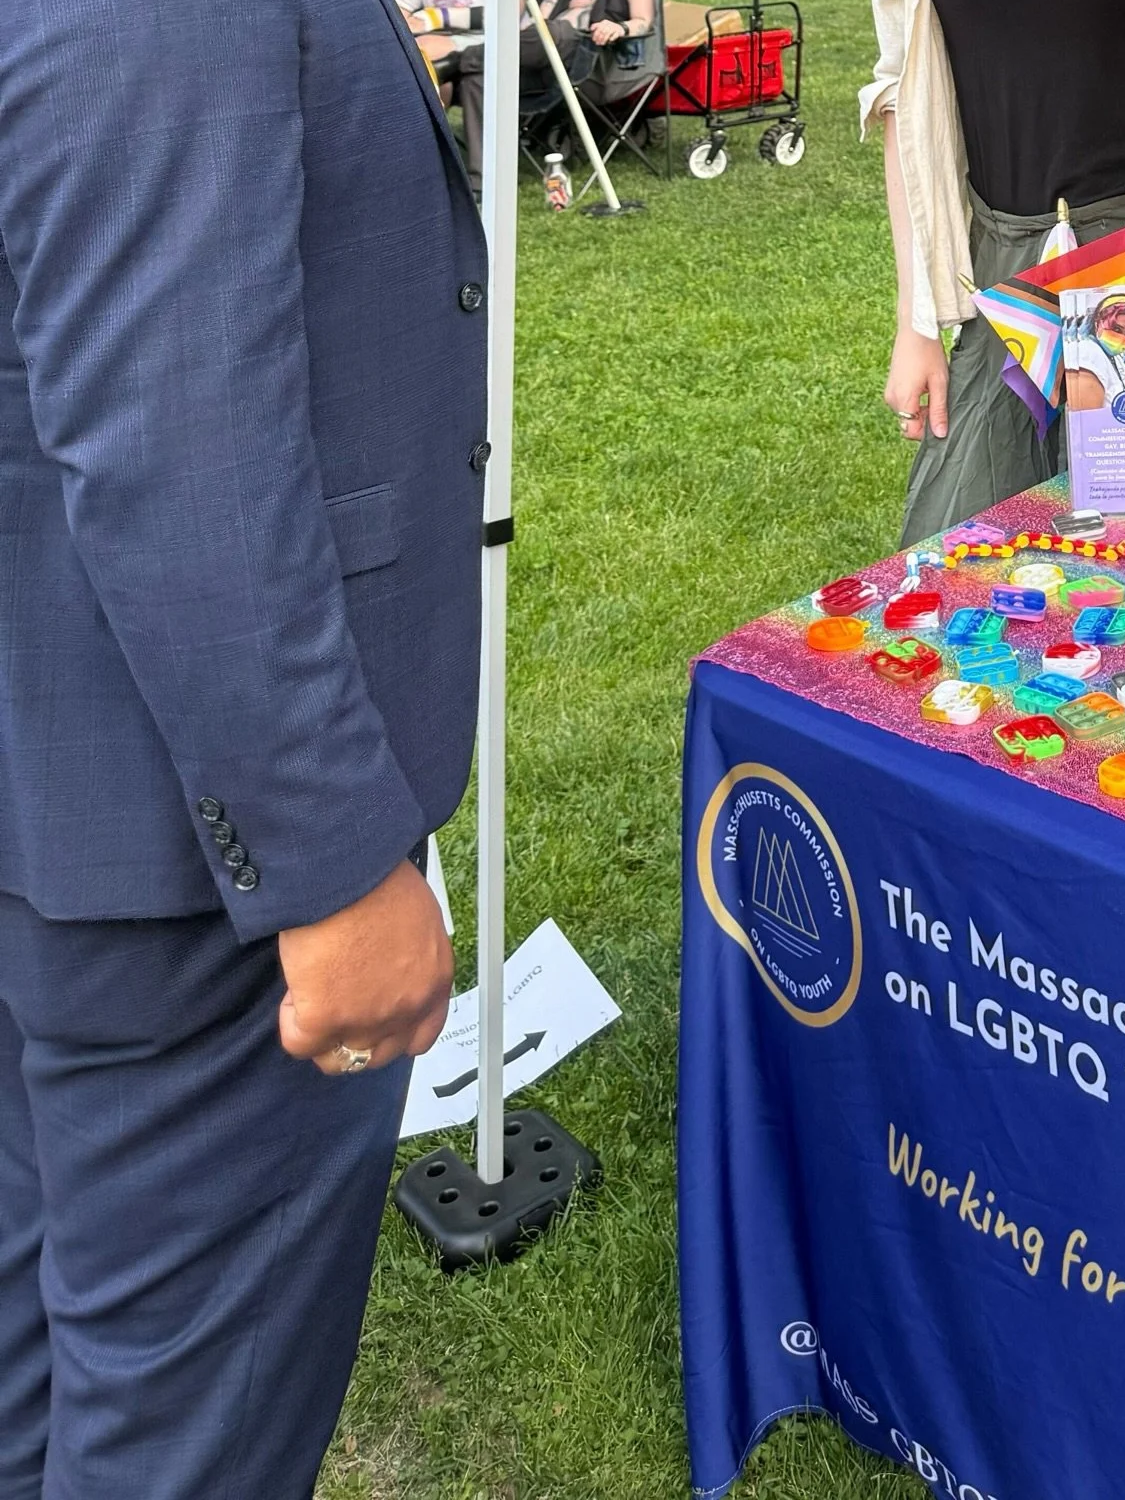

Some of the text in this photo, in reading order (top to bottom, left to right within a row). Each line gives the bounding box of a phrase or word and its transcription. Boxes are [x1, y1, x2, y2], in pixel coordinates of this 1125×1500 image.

[723, 790, 843, 918] MASSACHUSETTS COMMISSION
[881, 879, 952, 953] The
[750, 927, 833, 1000] ON LGBTQ YOUTH
[885, 971, 932, 1016] on
[948, 981, 1109, 1103] LGBTQ
[888, 1123, 1045, 1277] Working
